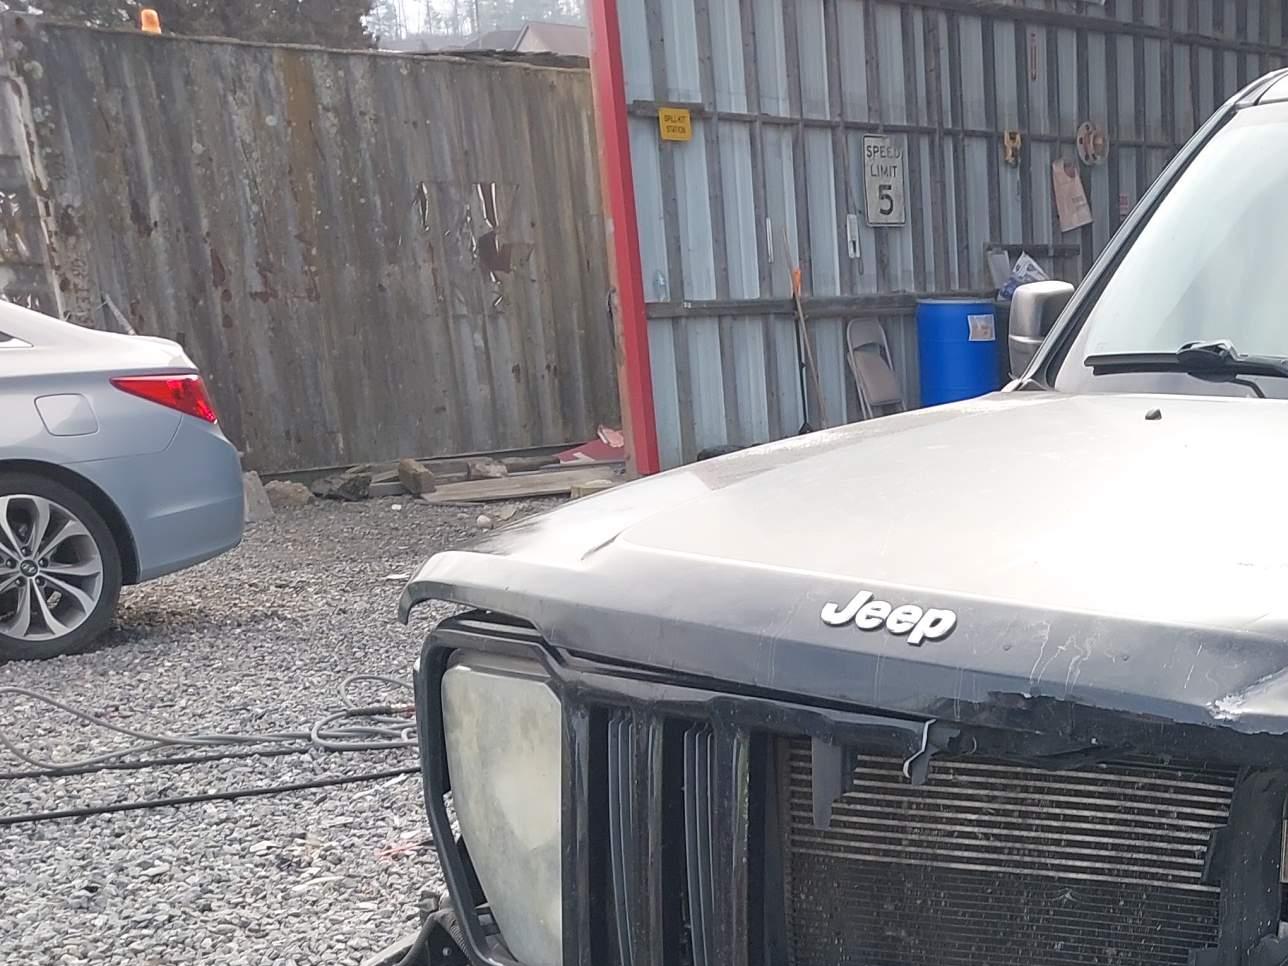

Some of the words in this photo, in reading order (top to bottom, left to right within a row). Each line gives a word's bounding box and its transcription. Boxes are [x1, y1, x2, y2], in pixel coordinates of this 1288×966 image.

[866, 145, 901, 159] SPEED
[870, 165, 898, 177] LIMIT
[878, 184, 894, 216] 5
[820, 590, 957, 646] Jeep
